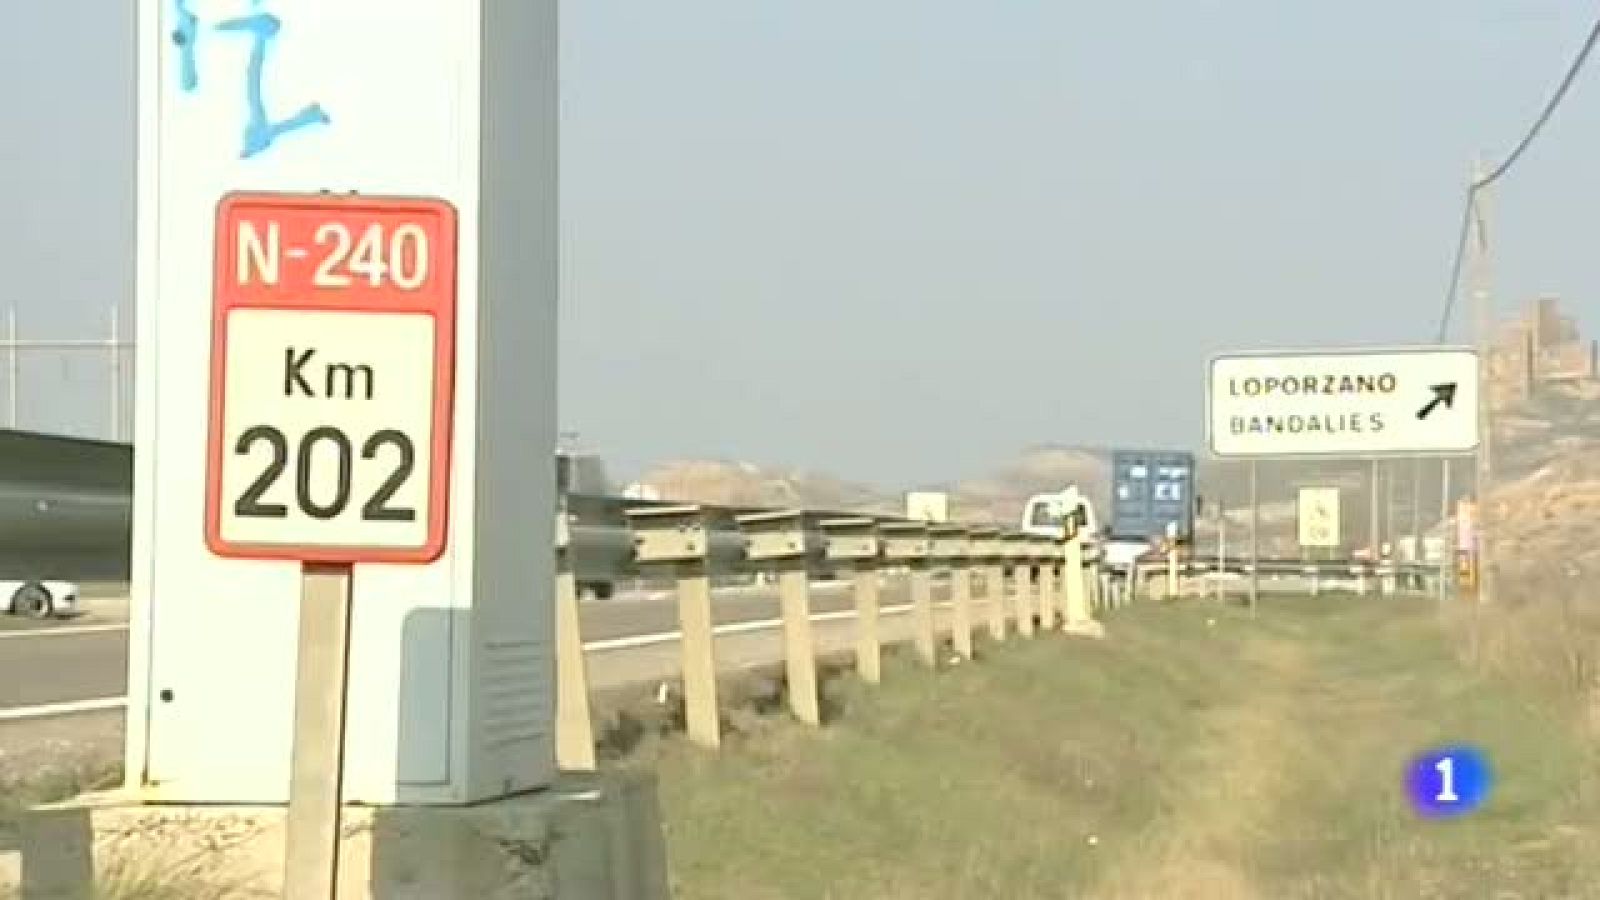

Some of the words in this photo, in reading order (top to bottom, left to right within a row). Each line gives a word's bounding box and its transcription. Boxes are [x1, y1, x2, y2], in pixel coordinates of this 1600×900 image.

[236, 220, 429, 289] N-240
[284, 346, 375, 400] Km
[1229, 372, 1398, 397] LOPORZANO
[1229, 412, 1386, 435] BANDALIES
[234, 424, 416, 521] 202
